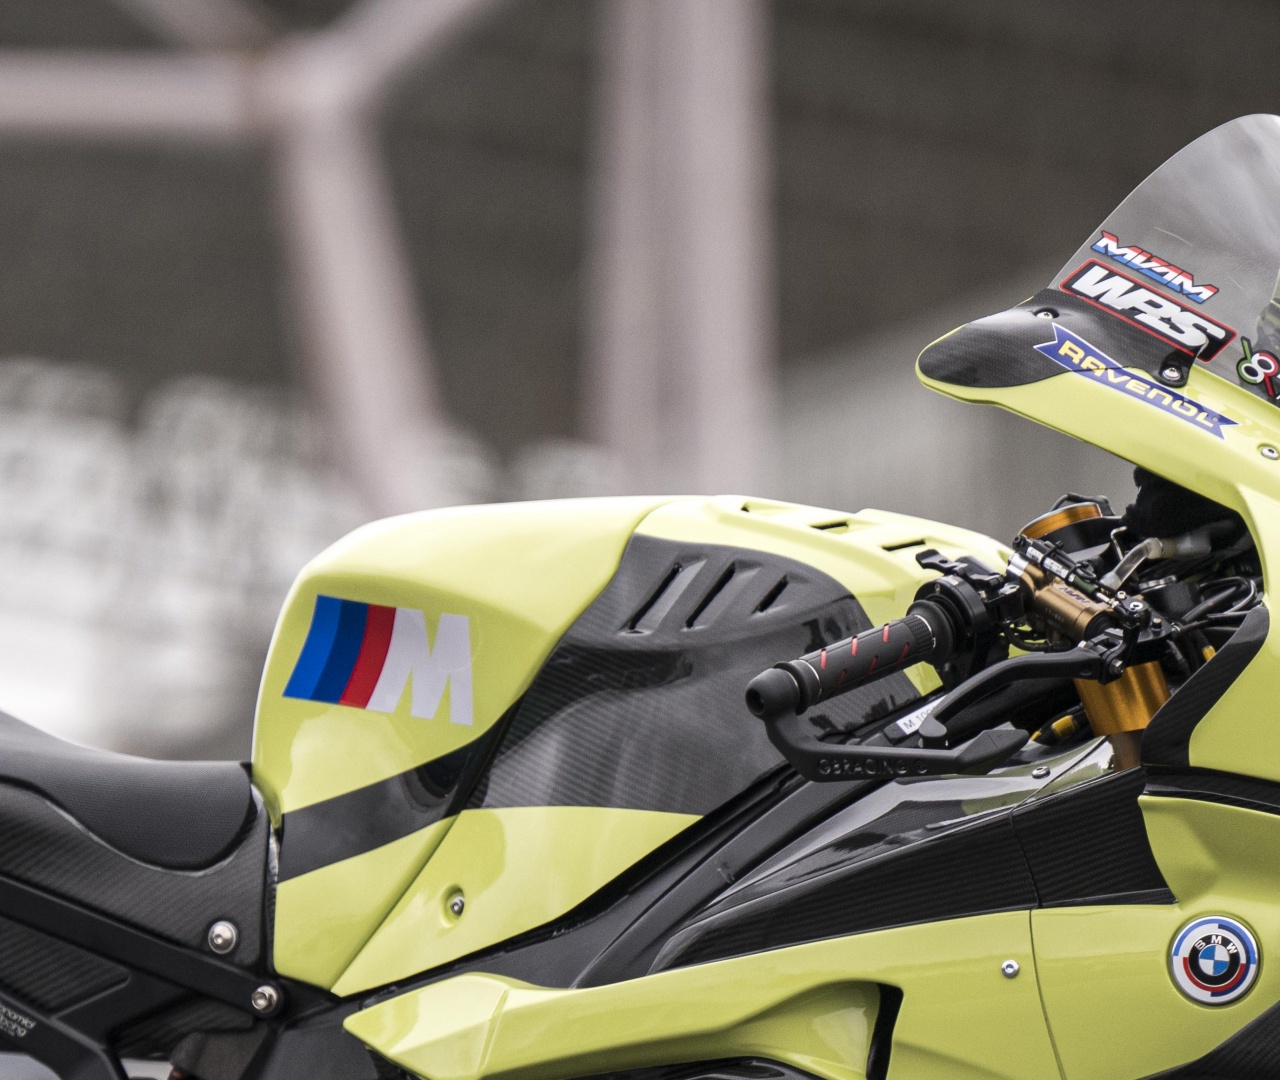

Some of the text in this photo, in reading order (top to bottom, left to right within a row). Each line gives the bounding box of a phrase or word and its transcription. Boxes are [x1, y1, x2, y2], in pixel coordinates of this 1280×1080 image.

[1070, 264, 1226, 347] WPS
[1057, 339, 1215, 428] RAVENOL
[1194, 934, 1238, 955] BMW
